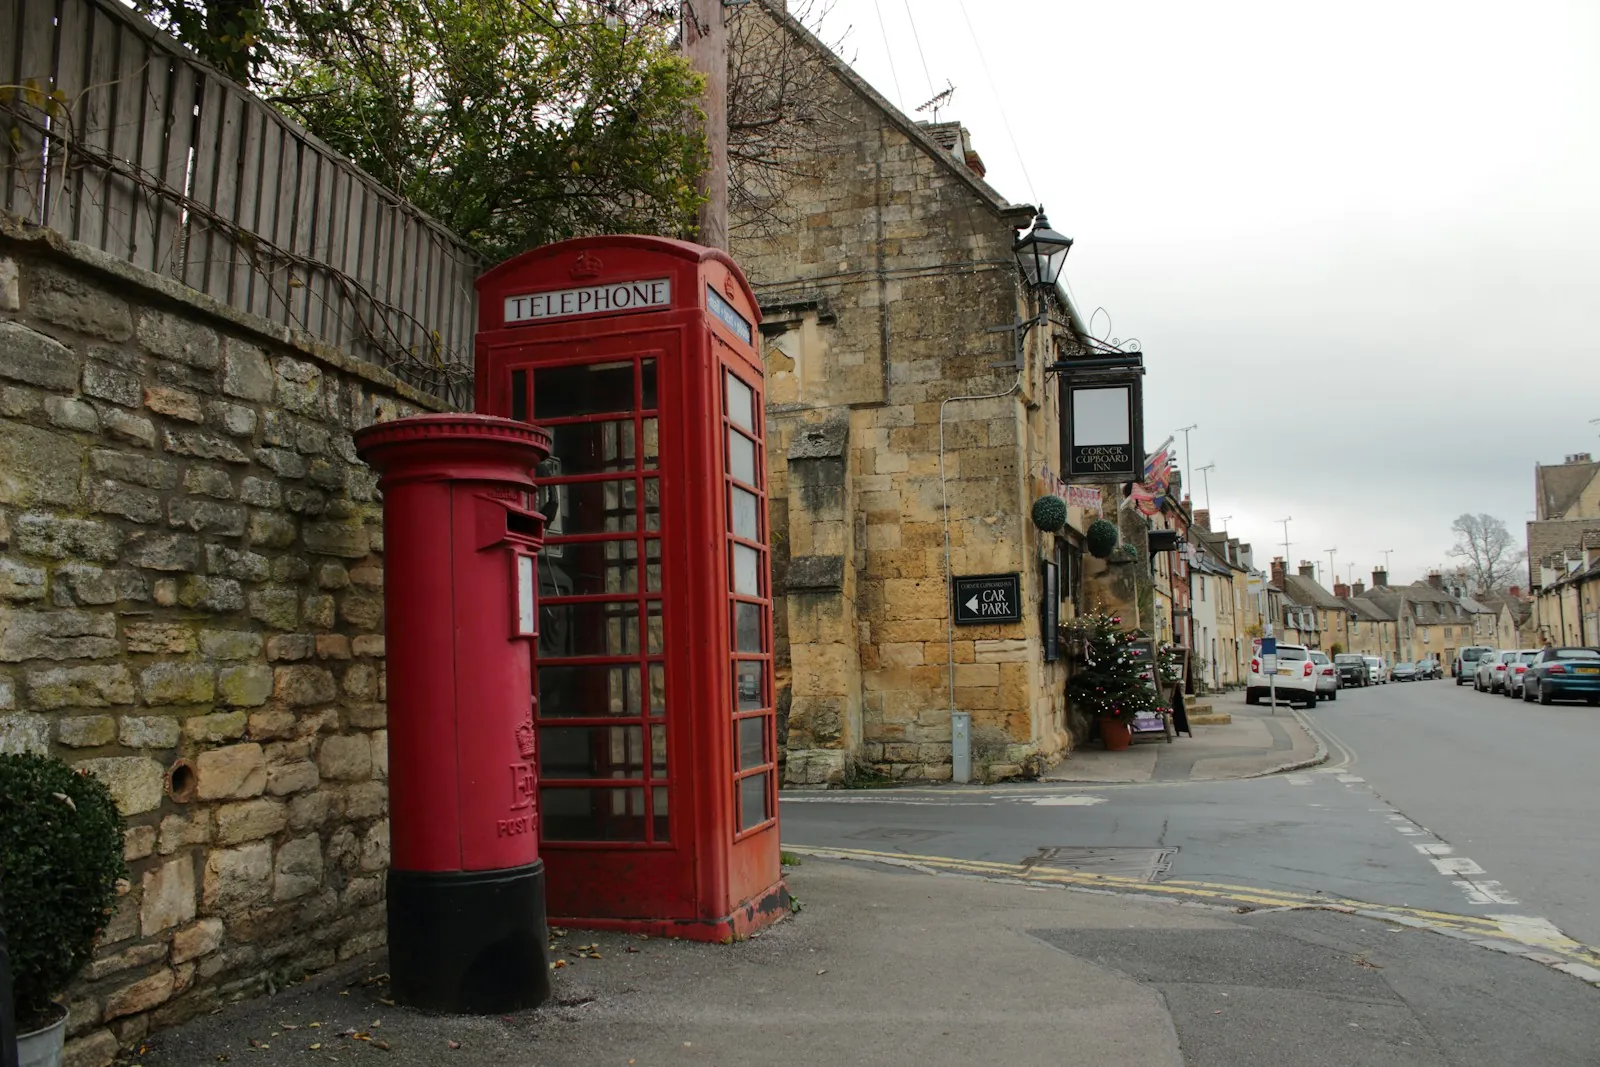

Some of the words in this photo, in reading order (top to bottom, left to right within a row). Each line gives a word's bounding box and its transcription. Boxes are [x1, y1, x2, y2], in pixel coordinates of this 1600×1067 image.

[512, 282, 665, 319] TELEPHONE
[1081, 446, 1123, 455] CORNER
[1075, 454, 1129, 464] CUPBOARD
[1093, 463, 1111, 472] INN
[982, 589, 1006, 603] CAR
[981, 602, 1011, 616] PARK
[497, 815, 529, 838] POST
